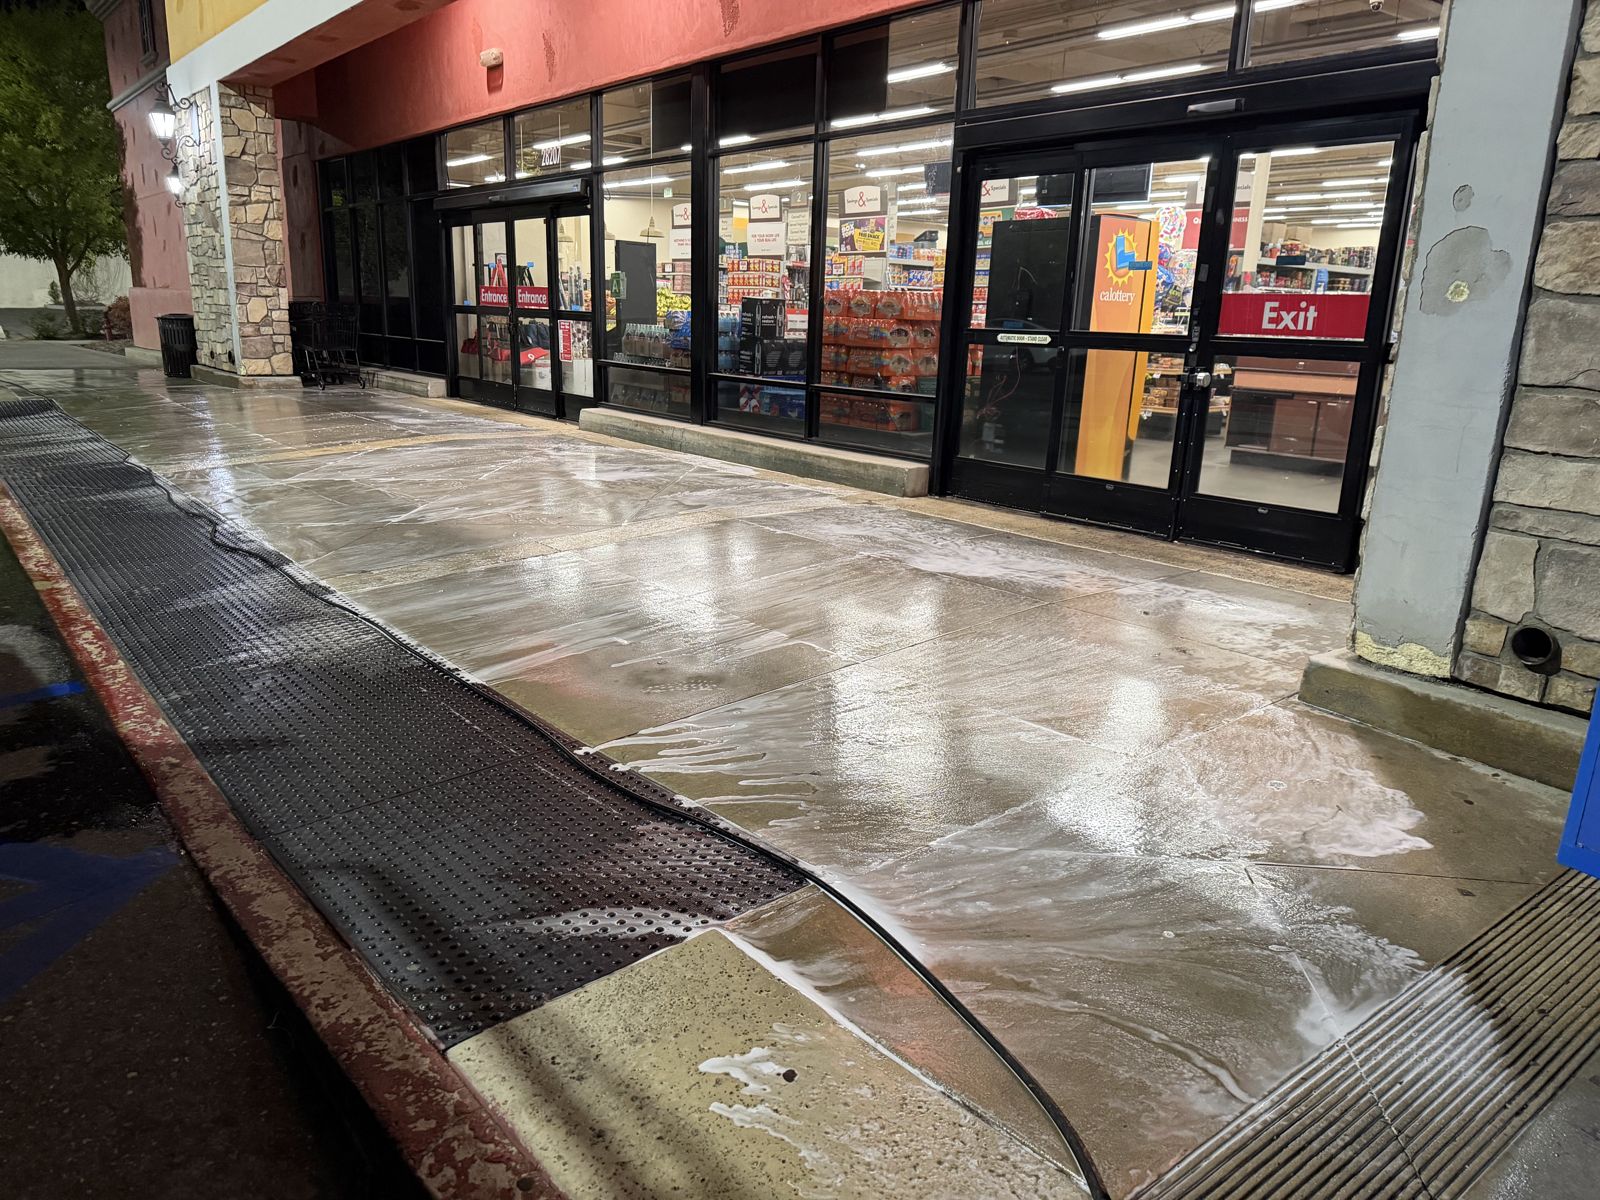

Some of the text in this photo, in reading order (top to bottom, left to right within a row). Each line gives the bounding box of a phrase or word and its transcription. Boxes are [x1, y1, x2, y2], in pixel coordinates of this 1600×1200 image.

[481, 289, 508, 303] Entrance
[517, 289, 547, 304] Entrance
[1100, 287, 1136, 306] calottery
[1261, 301, 1318, 331] Exit
